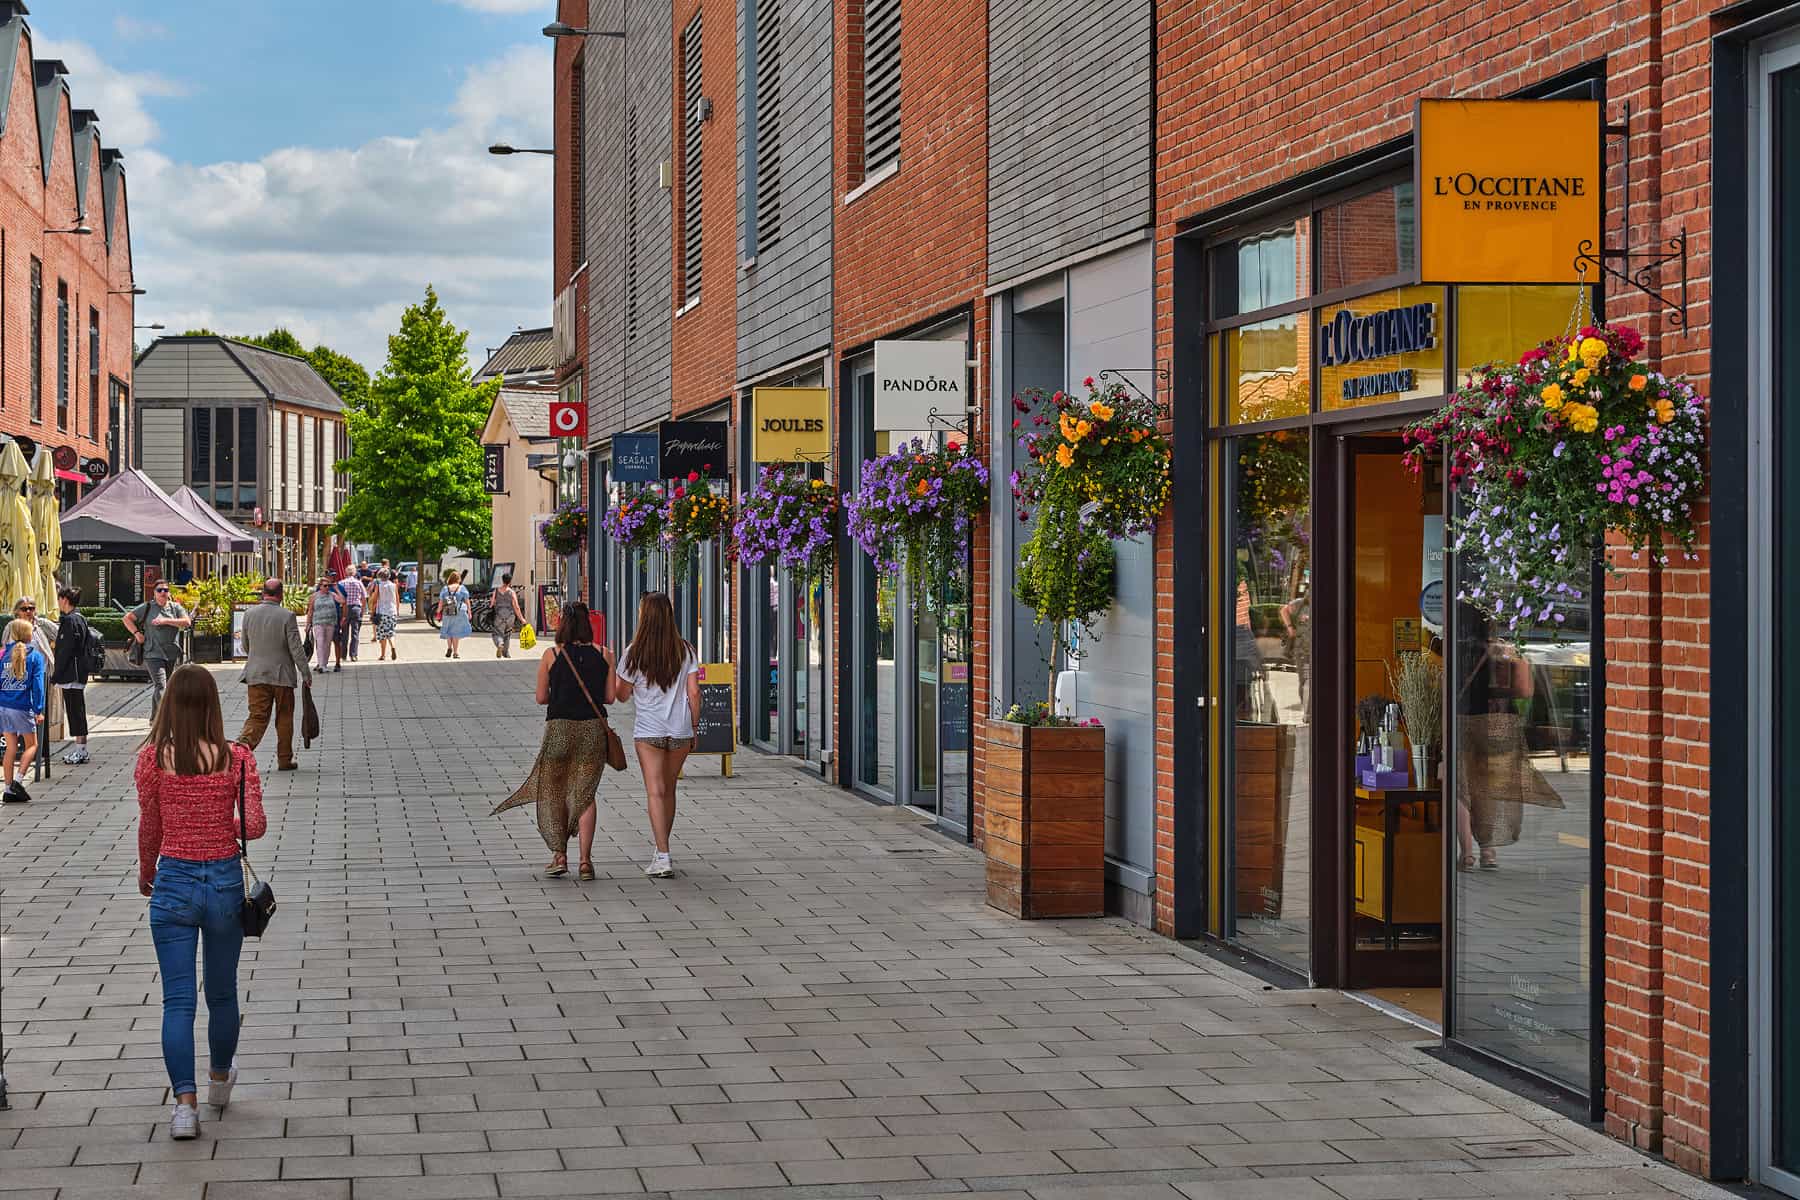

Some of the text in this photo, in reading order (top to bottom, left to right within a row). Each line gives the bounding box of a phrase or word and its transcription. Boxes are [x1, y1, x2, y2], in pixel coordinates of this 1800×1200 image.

[1434, 172, 1585, 197] L'OCCITANE
[1464, 200, 1557, 211] EN PROVENCE
[1320, 303, 1438, 368] L'OCCITANE
[1343, 370, 1410, 400] EN PROVENCE
[761, 419, 824, 433] JOULES
[618, 455, 656, 465] SEASALT
